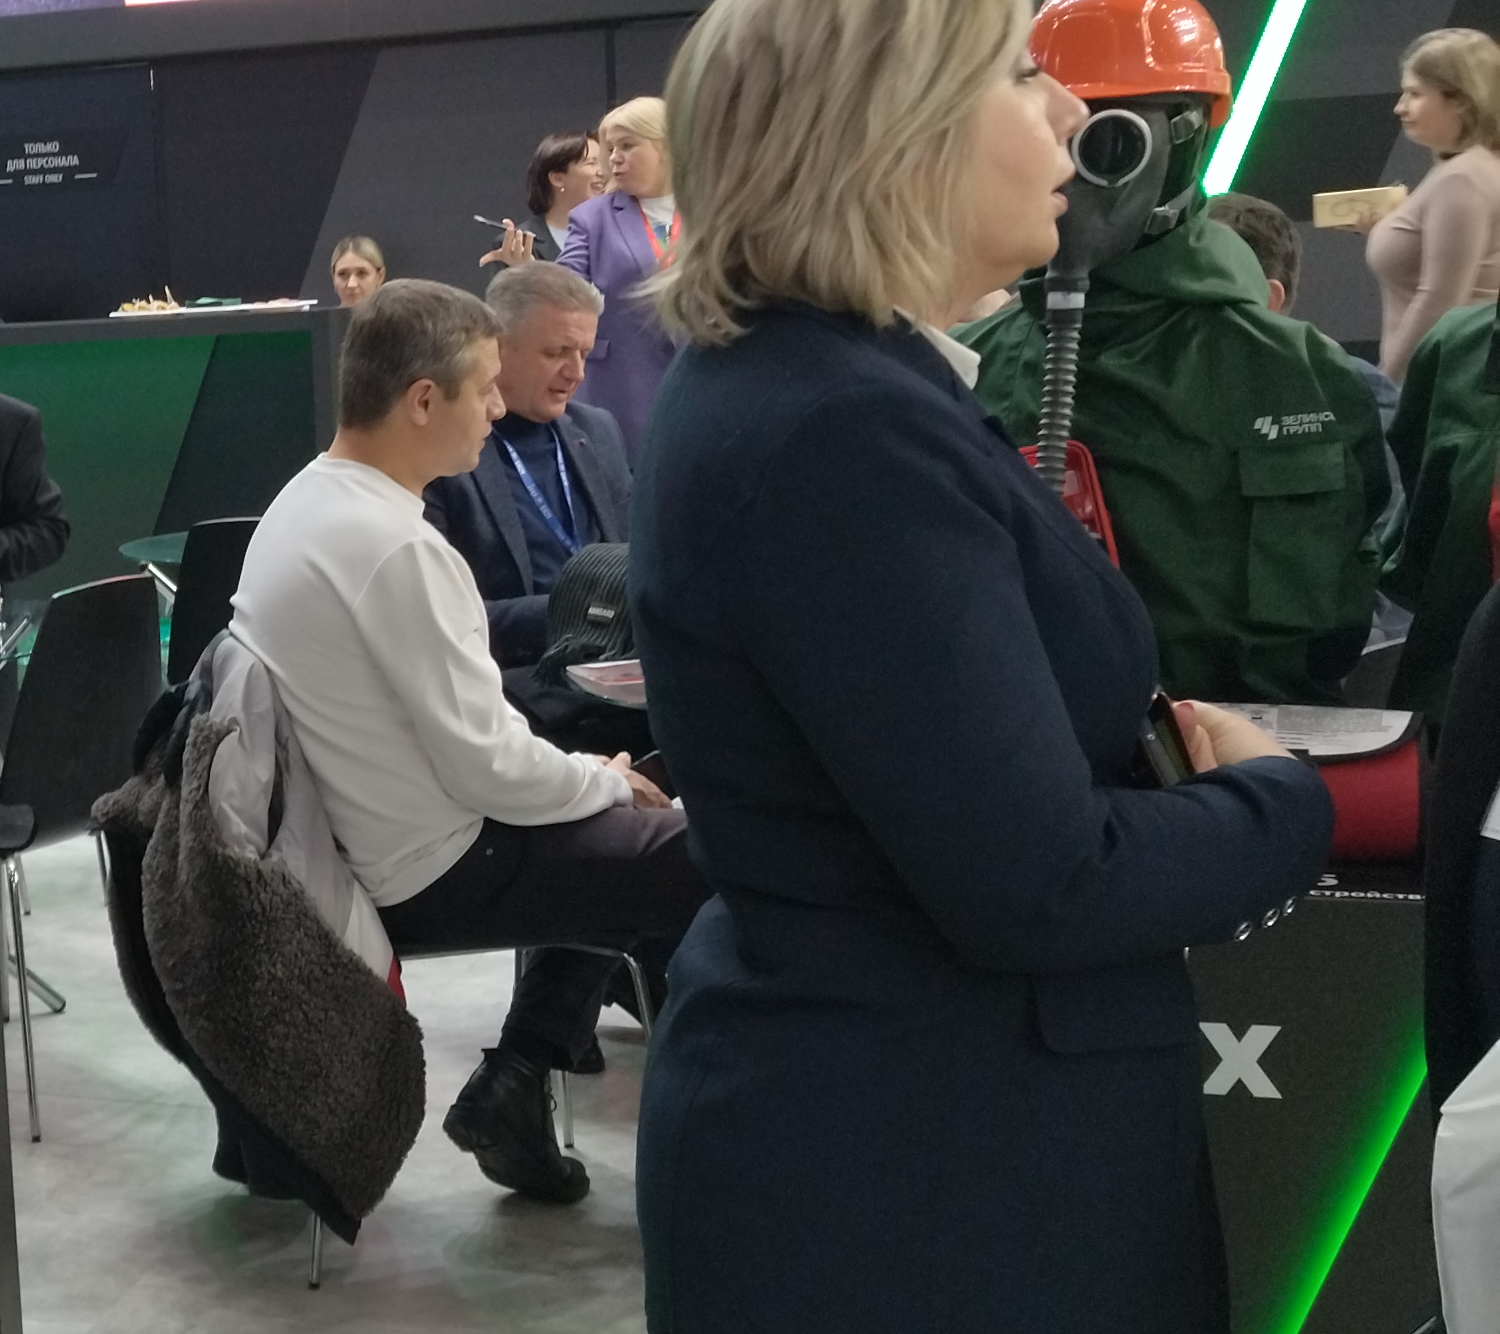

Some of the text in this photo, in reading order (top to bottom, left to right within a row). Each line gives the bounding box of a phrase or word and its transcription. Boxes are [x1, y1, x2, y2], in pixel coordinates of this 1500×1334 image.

[24, 140, 59, 155] ТОЛЬКО
[6, 154, 80, 173] ДЛЯ ПЕРСОНАЛА
[24, 173, 63, 185] STAFF ONLY
[1309, 889, 1425, 901] стройств
